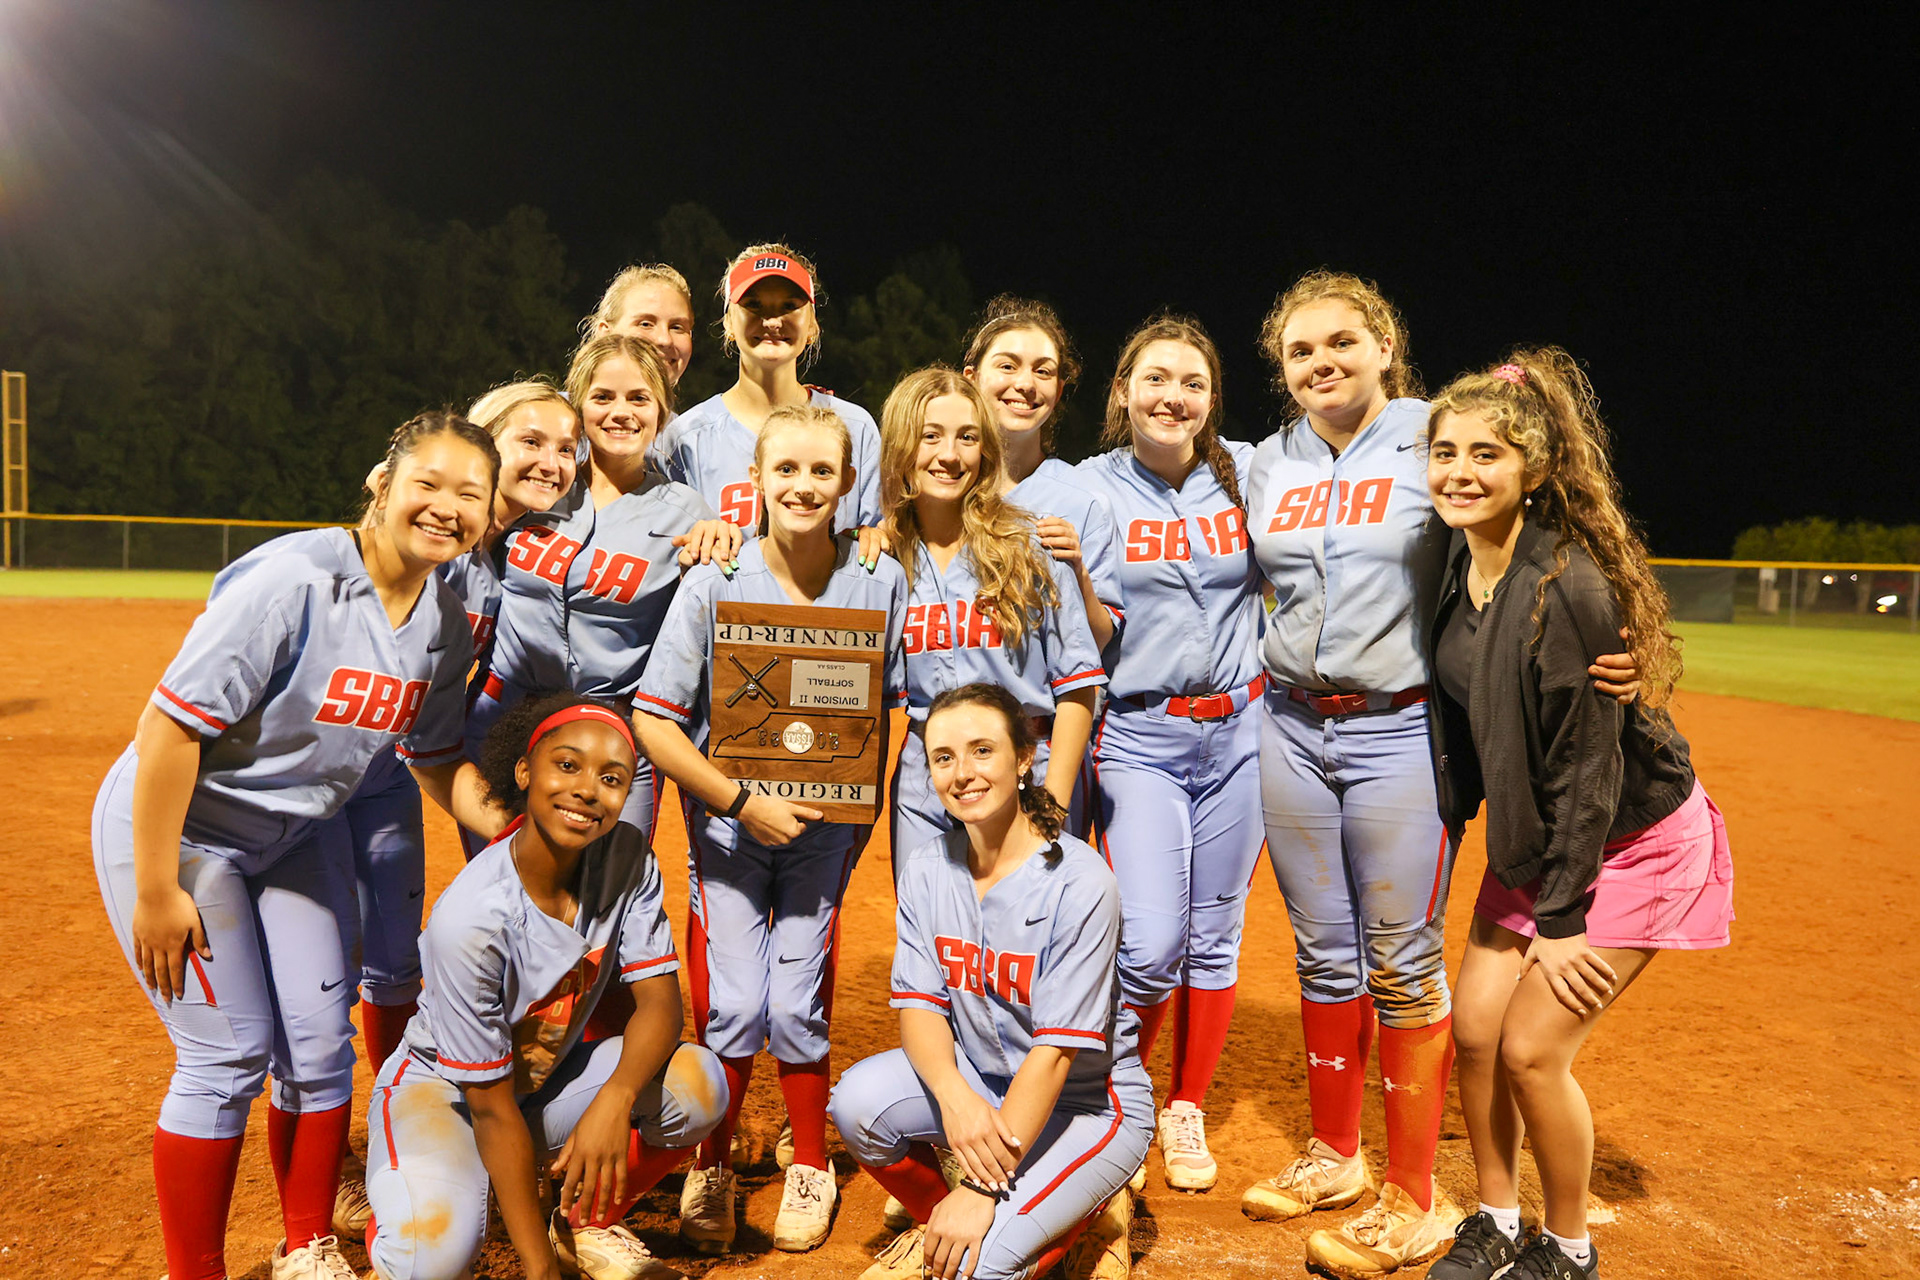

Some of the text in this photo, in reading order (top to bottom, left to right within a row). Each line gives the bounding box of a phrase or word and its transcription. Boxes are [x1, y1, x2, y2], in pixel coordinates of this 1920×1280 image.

[1125, 506, 1248, 563] SBA
[1265, 477, 1394, 536] SBA
[507, 524, 652, 605] SBA
[902, 598, 1004, 656] SBA
[311, 665, 432, 735] SBA
[806, 677, 854, 688] SOFTBALL
[813, 695, 859, 706] DIVISION
[730, 780, 863, 801] REGIONA
[934, 934, 1038, 1008] SBA
